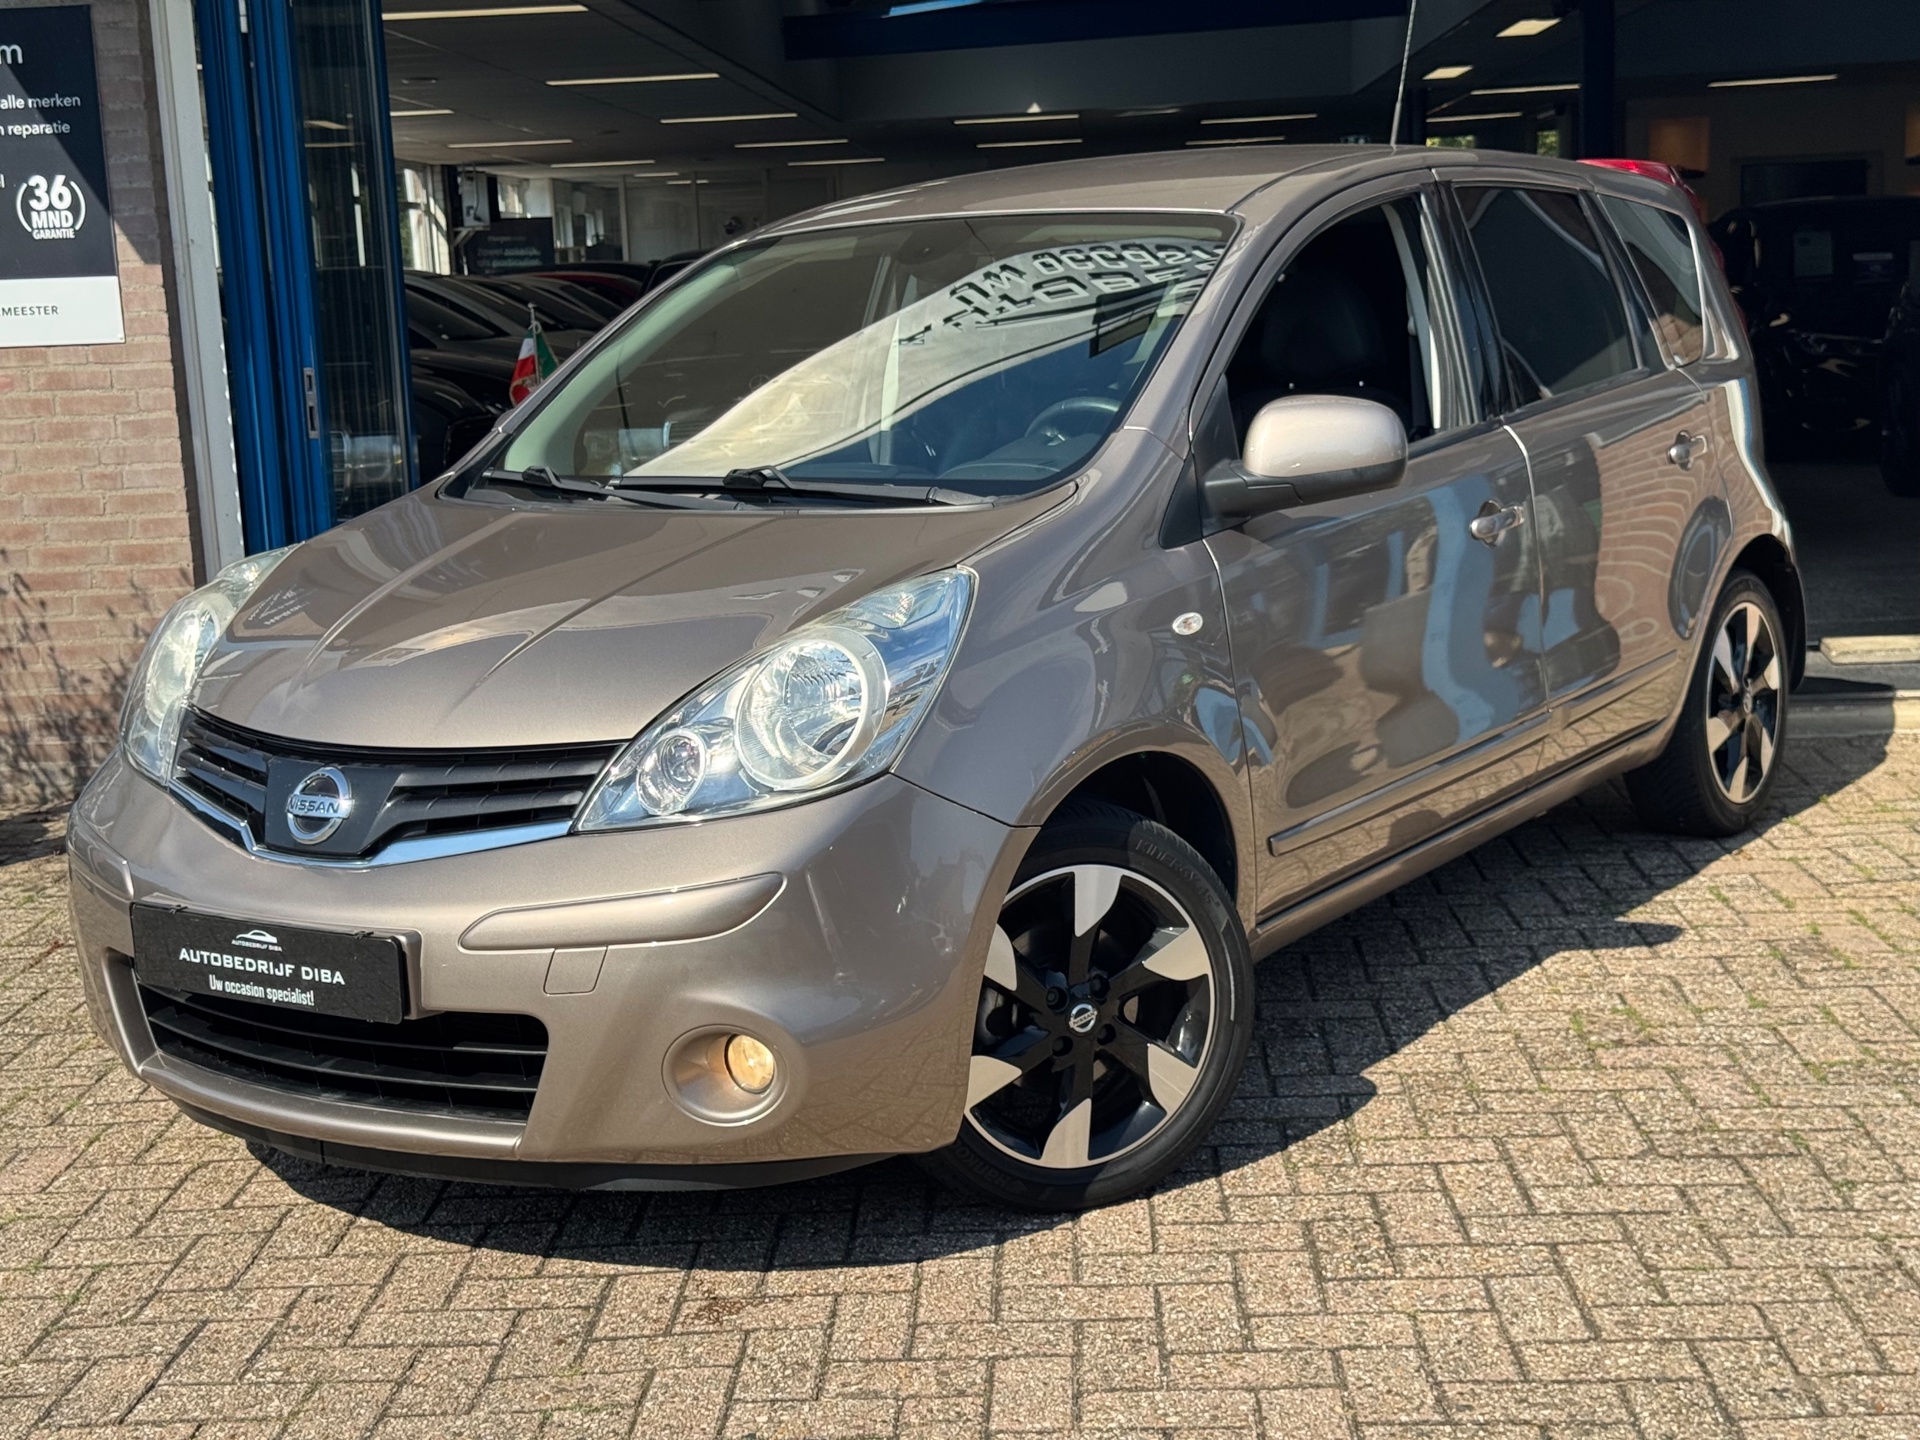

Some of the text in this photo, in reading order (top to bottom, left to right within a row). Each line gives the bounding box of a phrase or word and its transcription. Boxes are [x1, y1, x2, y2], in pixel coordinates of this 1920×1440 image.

[0, 93, 81, 110] alle merken
[8, 120, 71, 139] reparatie
[28, 174, 72, 211] 36
[30, 210, 74, 229] MND
[32, 228, 75, 240] GARANTIE
[288, 798, 340, 814] NISSAN
[179, 947, 346, 985] AUTOBEDRIJF DIBA
[208, 973, 315, 1006] Uw occasion specialist!
